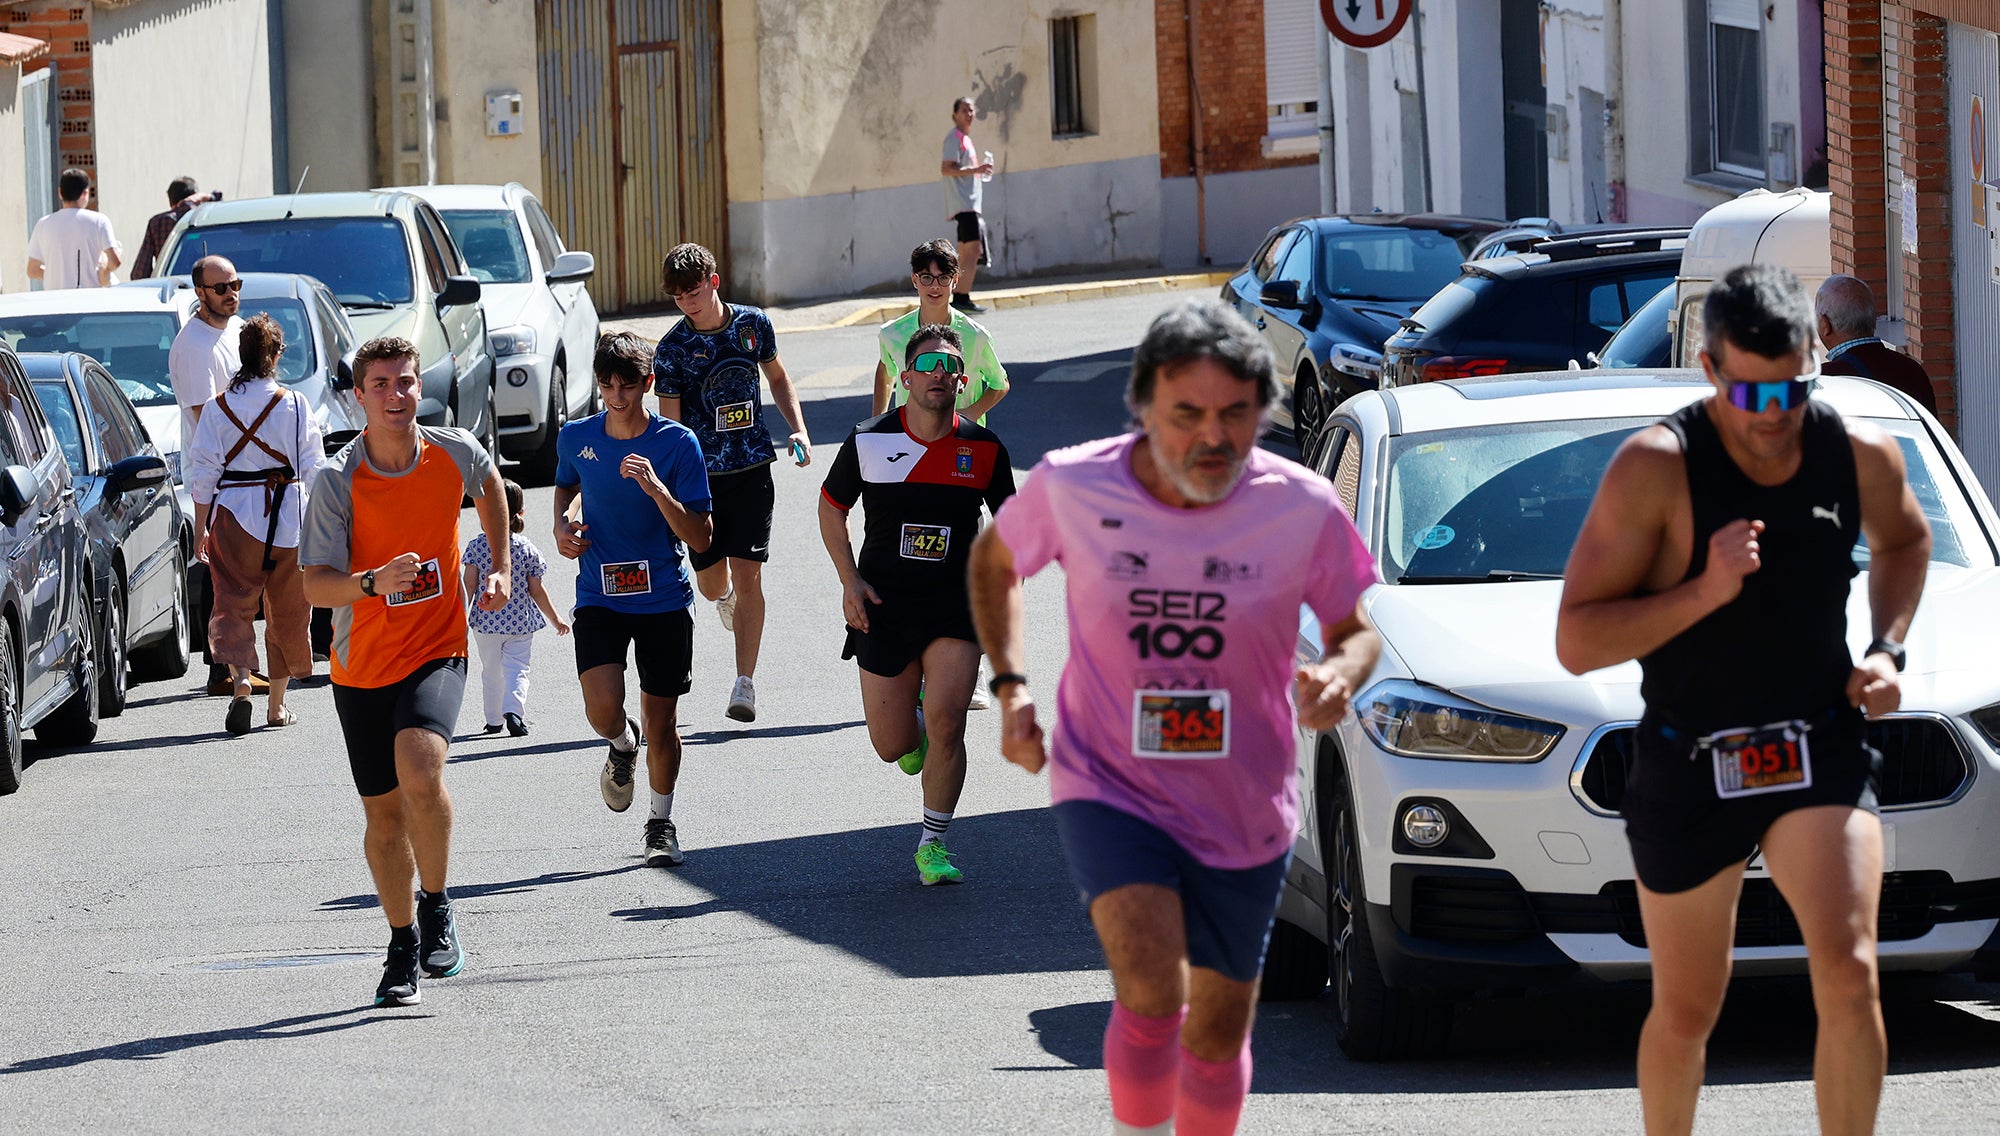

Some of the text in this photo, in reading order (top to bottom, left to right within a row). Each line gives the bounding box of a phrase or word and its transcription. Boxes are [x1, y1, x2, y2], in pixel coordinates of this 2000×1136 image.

[727, 409, 750, 423] 591
[914, 535, 946, 551] 475
[403, 571, 438, 594] 59
[615, 570, 647, 587] 360
[1129, 588, 1226, 622] SER
[1128, 622, 1225, 661] 100
[1161, 709, 1222, 739] 363
[1741, 741, 1798, 775] 051
